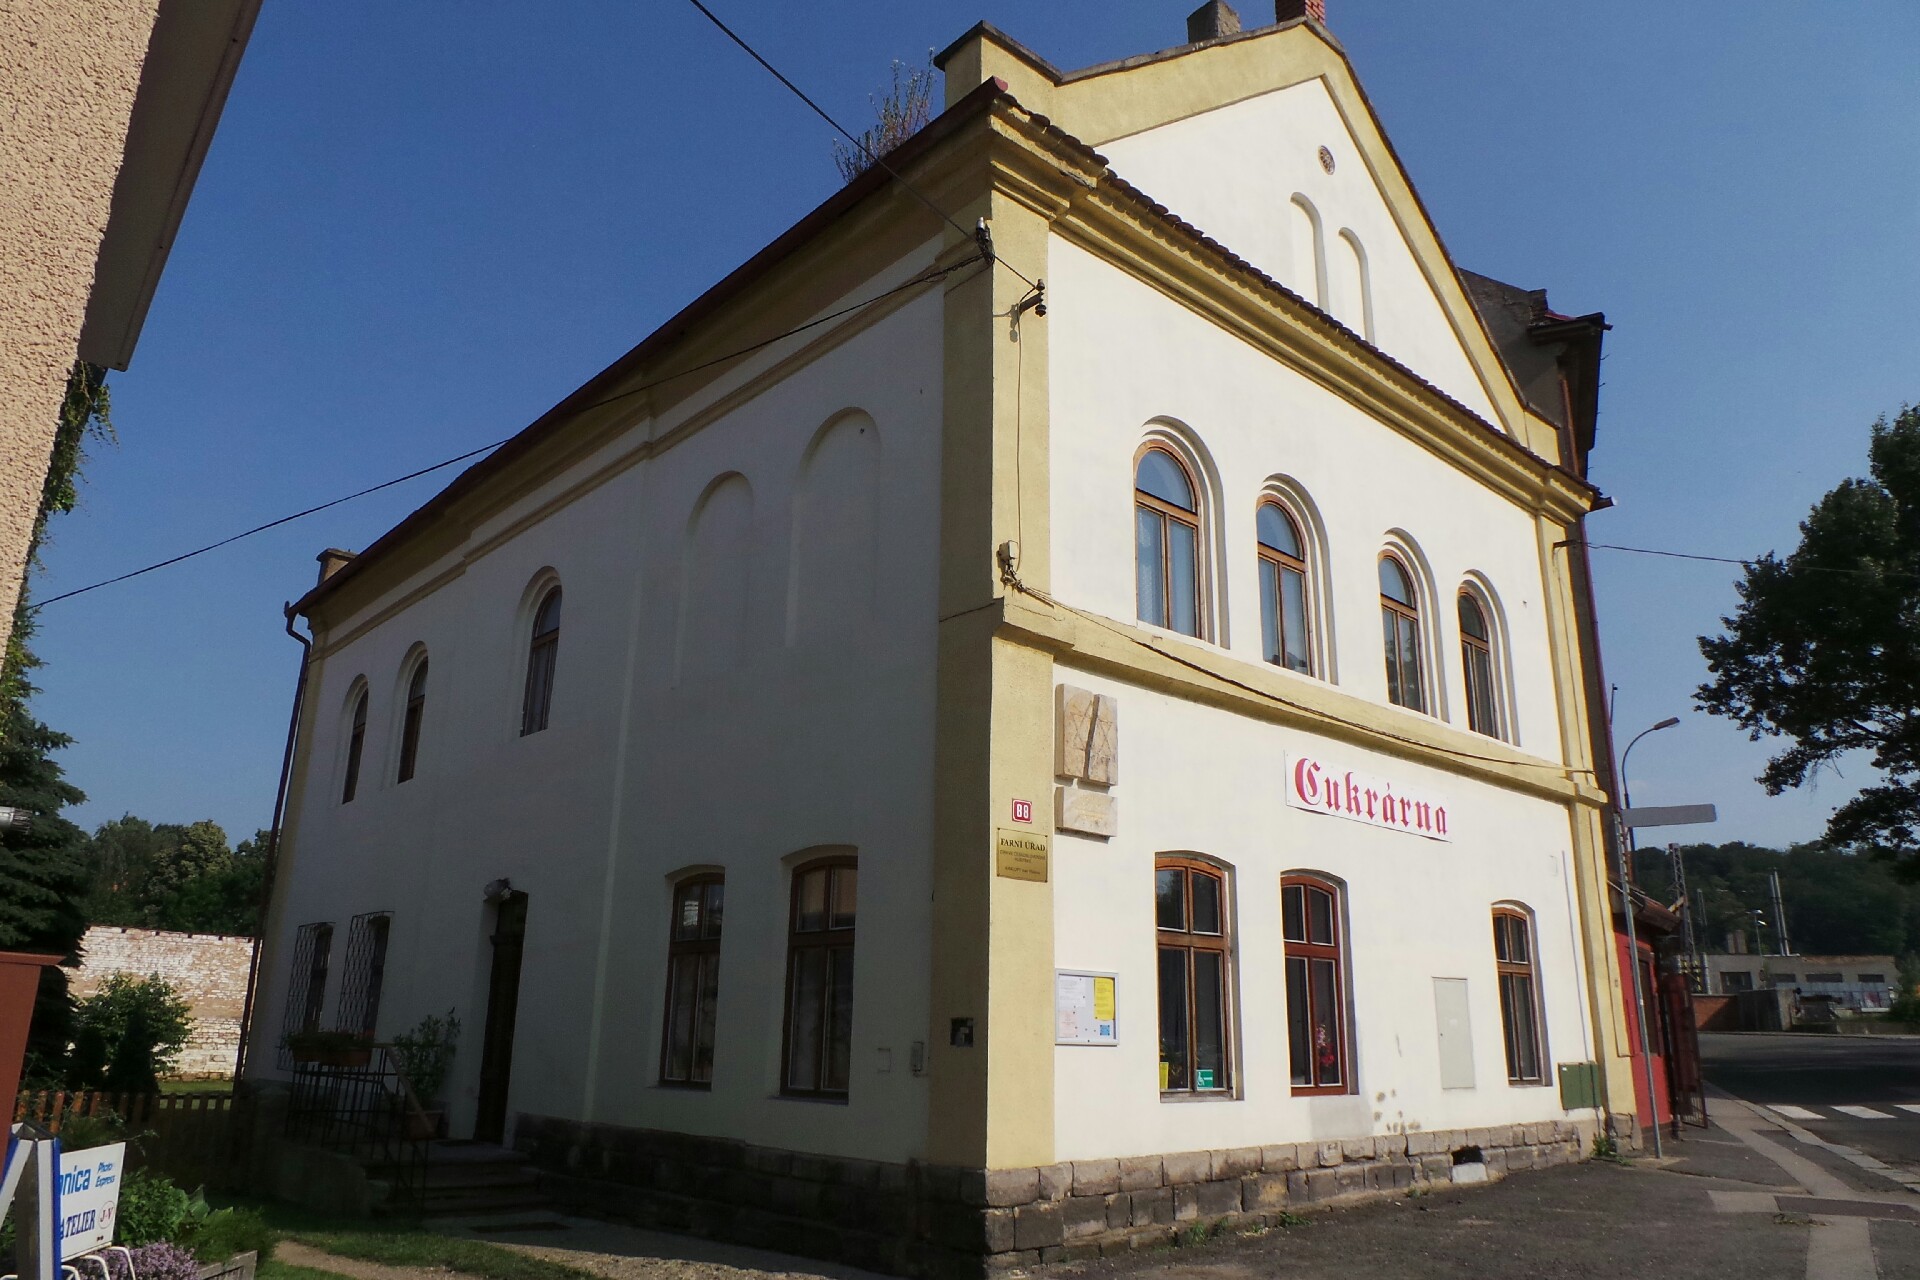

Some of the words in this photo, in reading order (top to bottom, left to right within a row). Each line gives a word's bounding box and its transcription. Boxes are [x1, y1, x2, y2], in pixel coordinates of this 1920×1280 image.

[1294, 757, 1448, 835] Cukrárna
[1017, 803, 1029, 818] 88
[96, 1175, 115, 1187] Express
